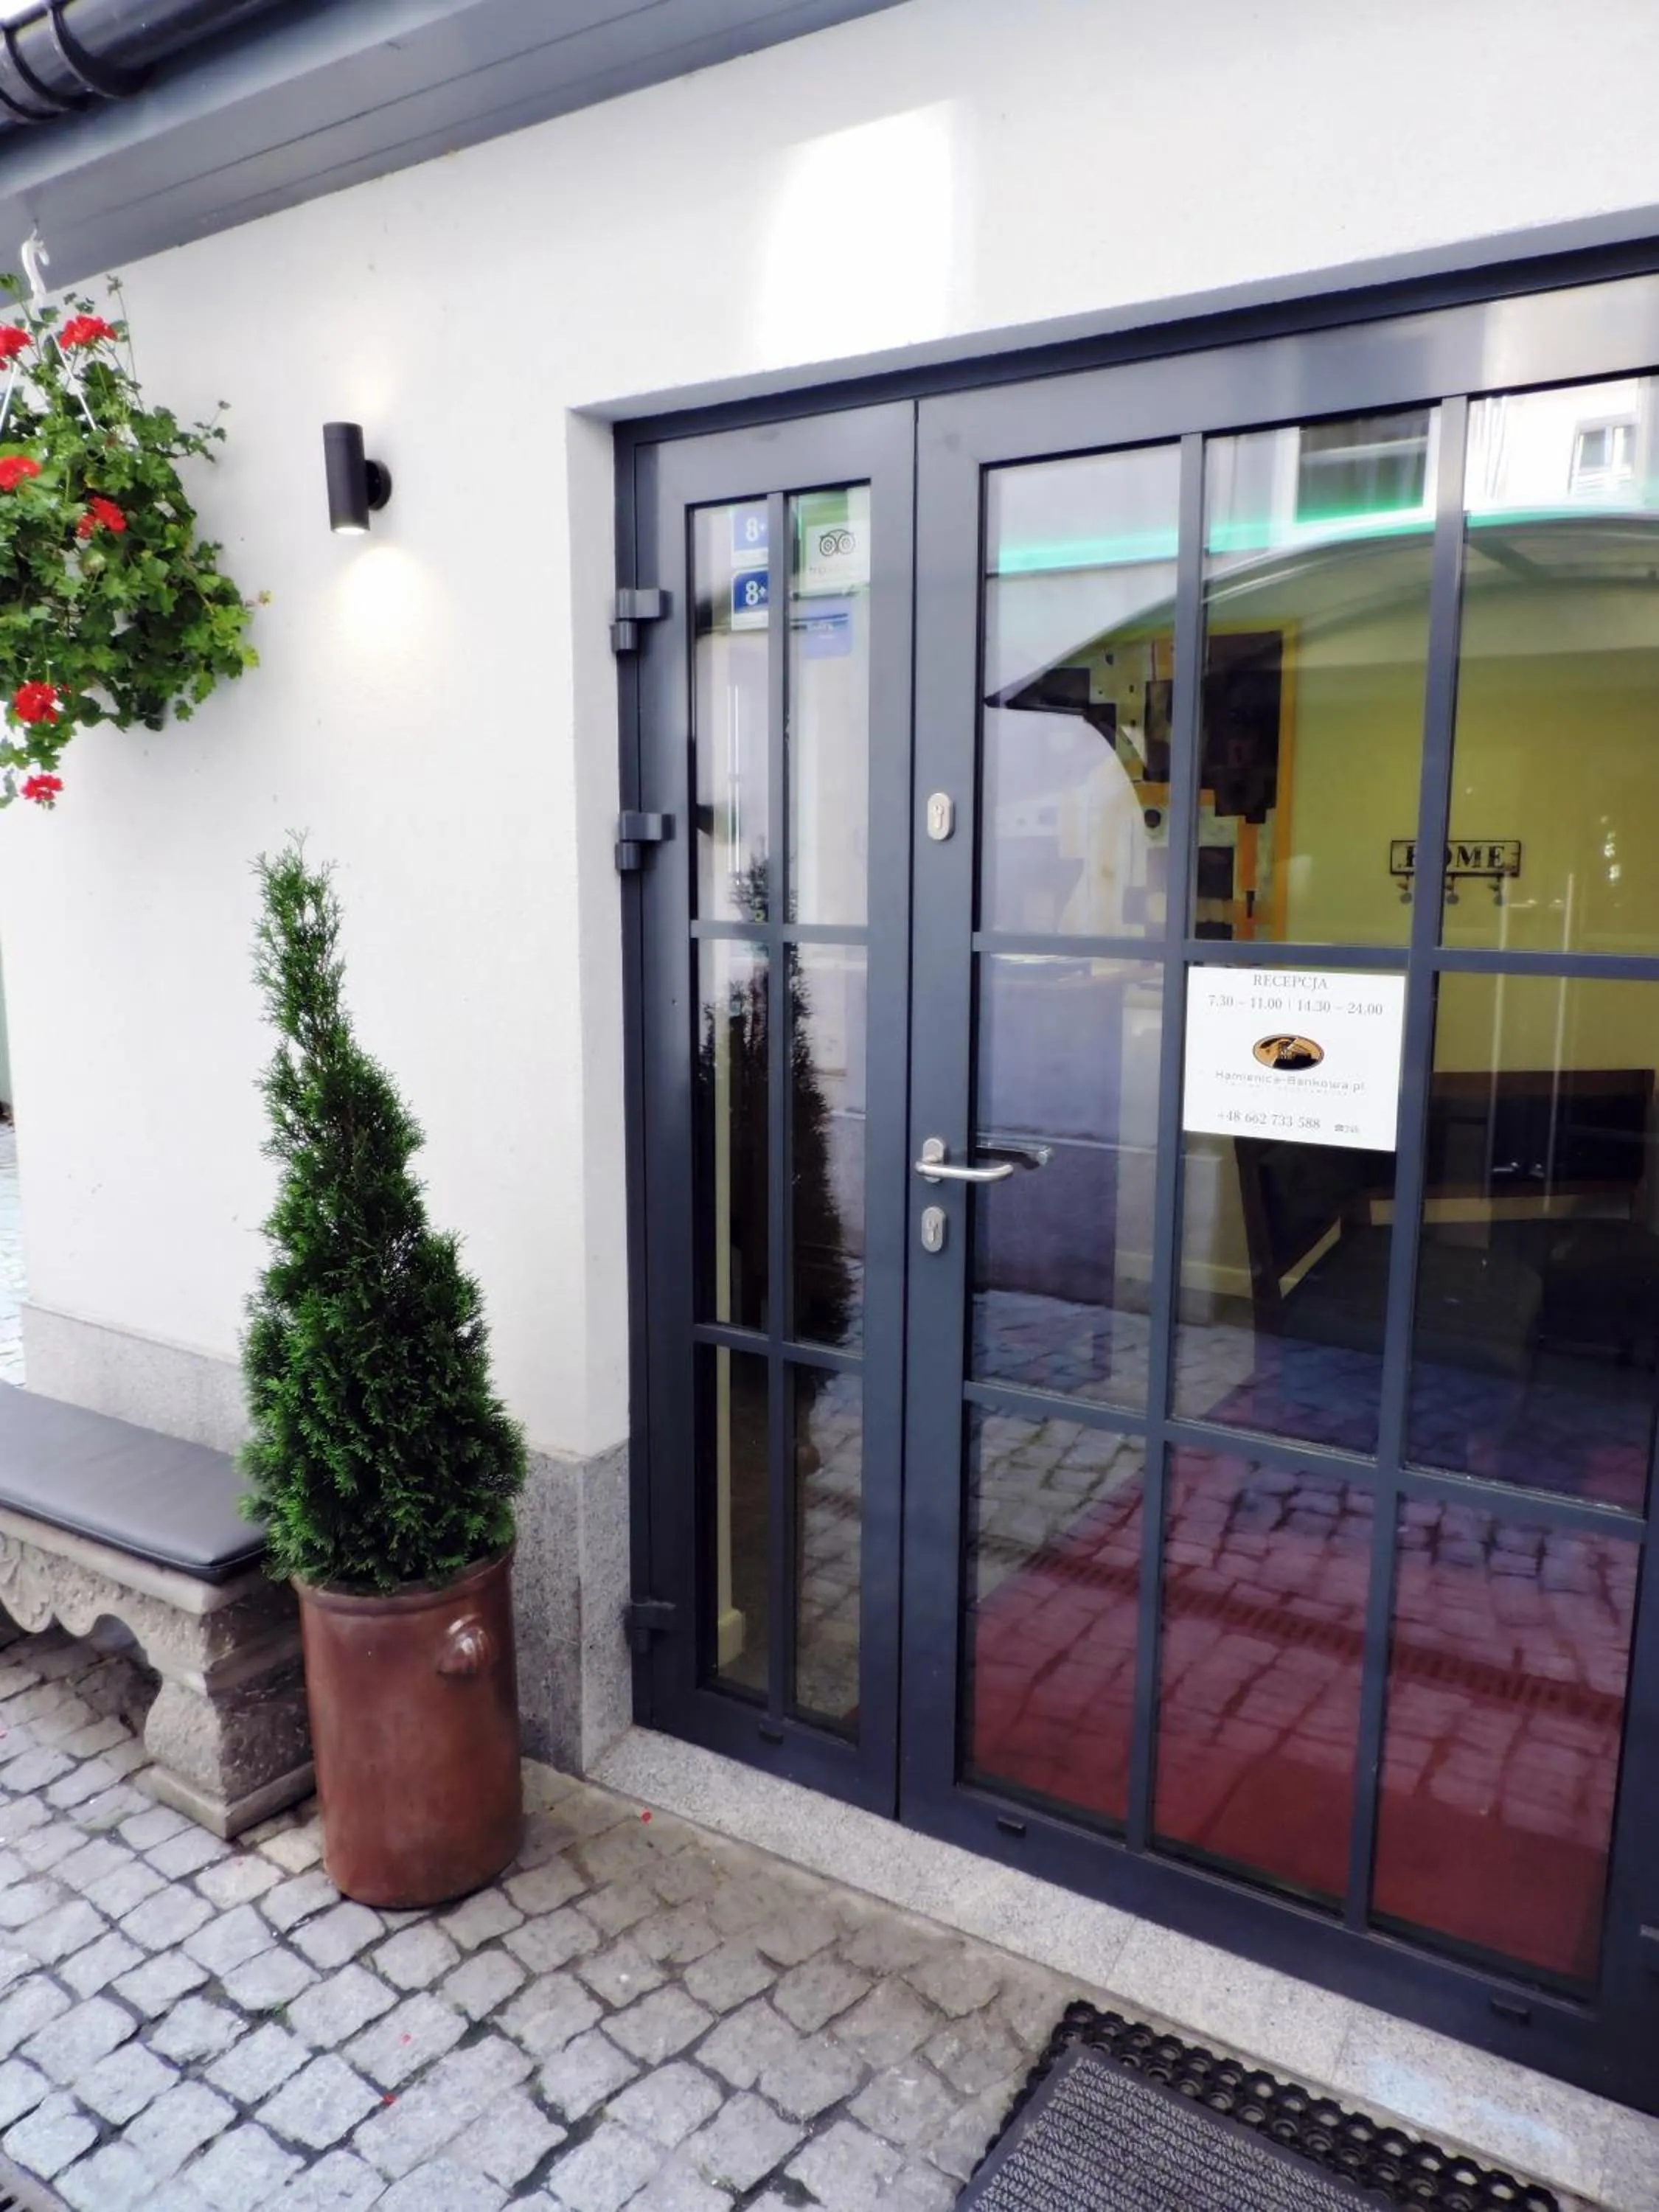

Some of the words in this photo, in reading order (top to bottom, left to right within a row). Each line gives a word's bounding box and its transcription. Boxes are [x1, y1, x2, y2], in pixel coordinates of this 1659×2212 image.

[1253, 974, 1328, 991] RECEPCJA
[1208, 995, 1234, 1007] 7.30
[1251, 997, 1282, 1010] 11.00
[1298, 999, 1331, 1012] 14.30
[1347, 1001, 1384, 1016] 24.00
[1298, 1116, 1321, 1130] 588
